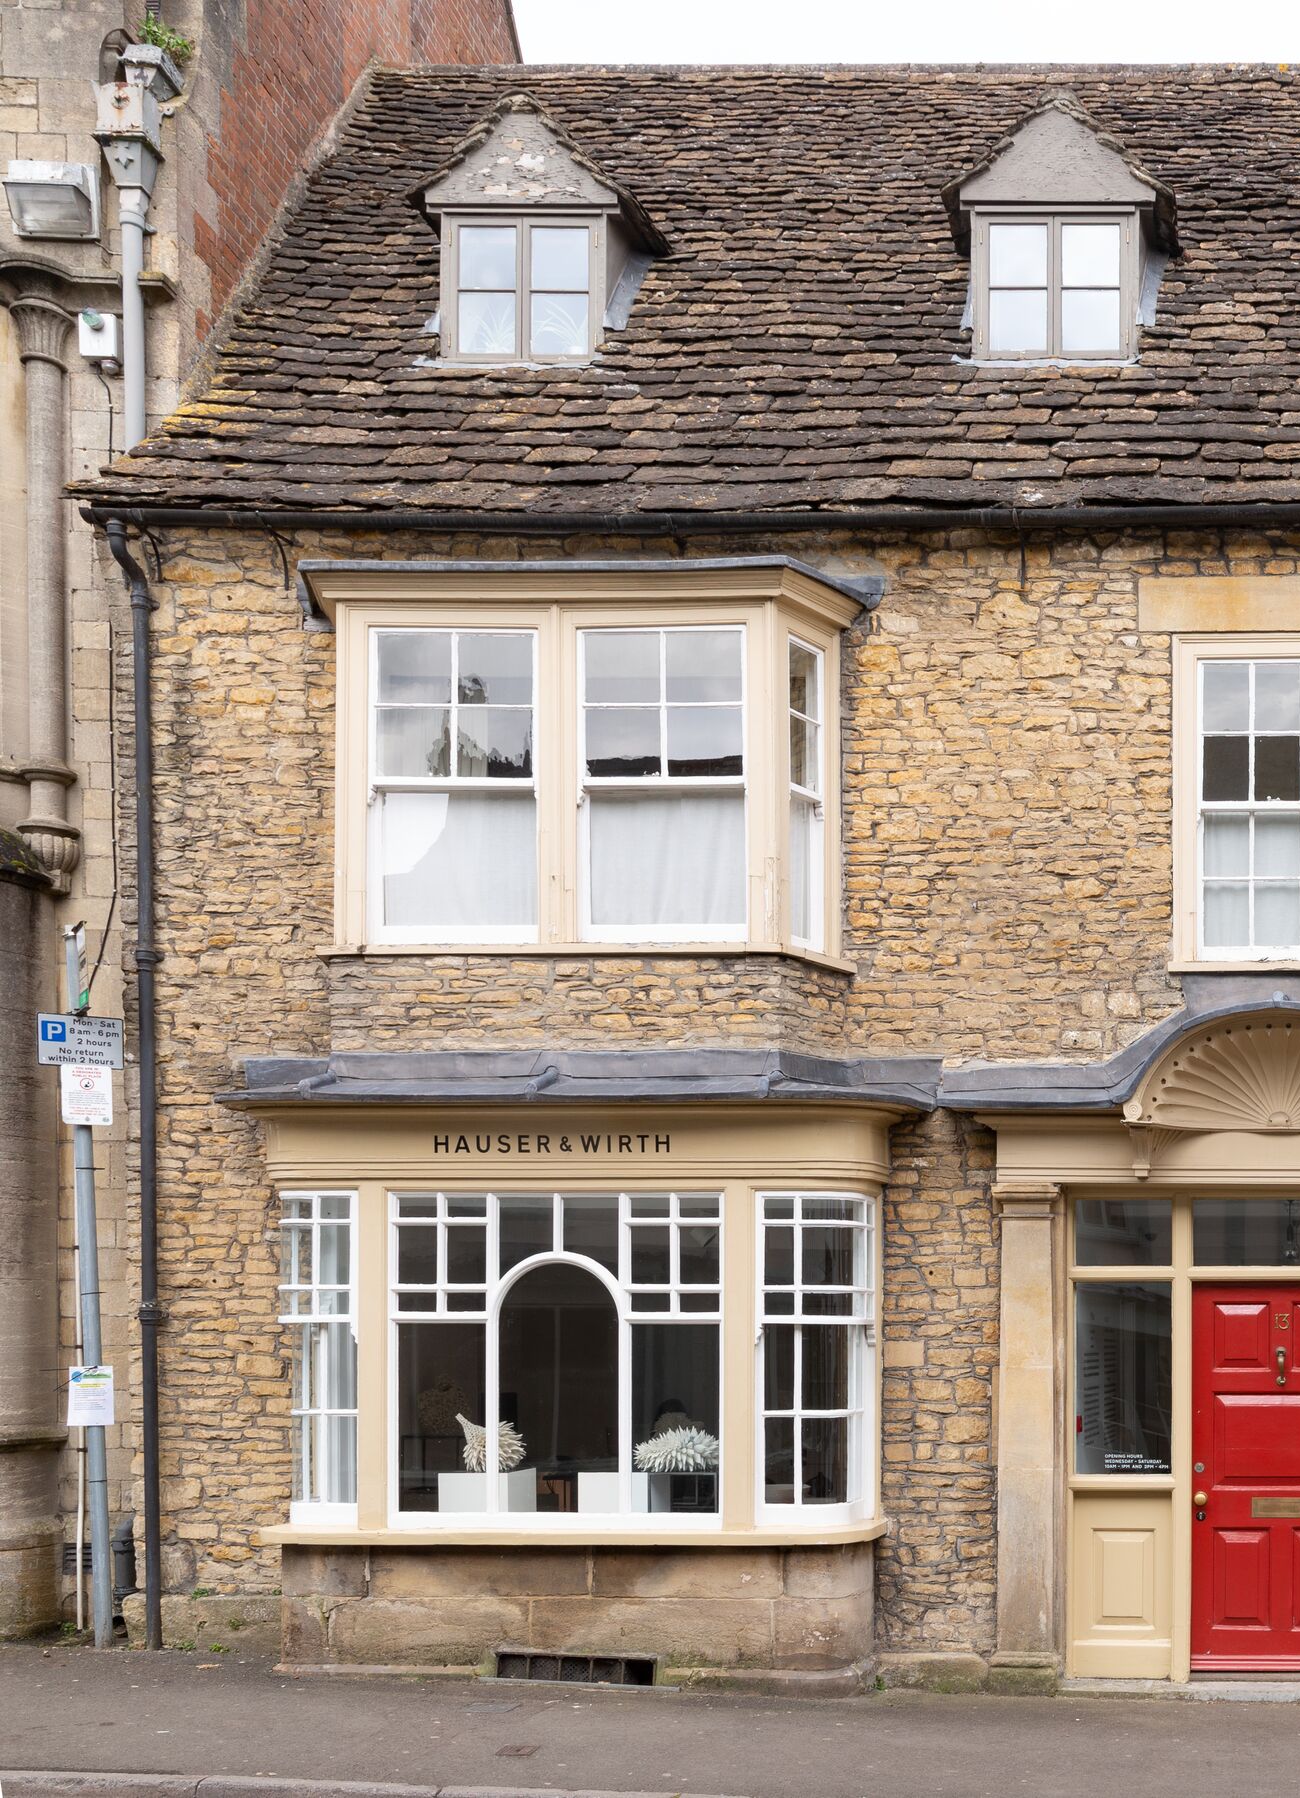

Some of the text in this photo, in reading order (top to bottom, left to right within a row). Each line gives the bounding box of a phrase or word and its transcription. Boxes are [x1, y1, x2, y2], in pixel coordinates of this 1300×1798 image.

[73, 1018, 93, 1027] Mon
[100, 1020, 116, 1028] Sat
[47, 1022, 63, 1040] P
[69, 1027, 76, 1035] 8
[97, 1029, 104, 1037] 6
[86, 1039, 112, 1047] hours
[59, 1047, 104, 1057] No return
[48, 1055, 115, 1066] within 2 hours
[433, 1134, 671, 1154] HAUSER & WIRTH
[1274, 1313, 1290, 1330] 13
